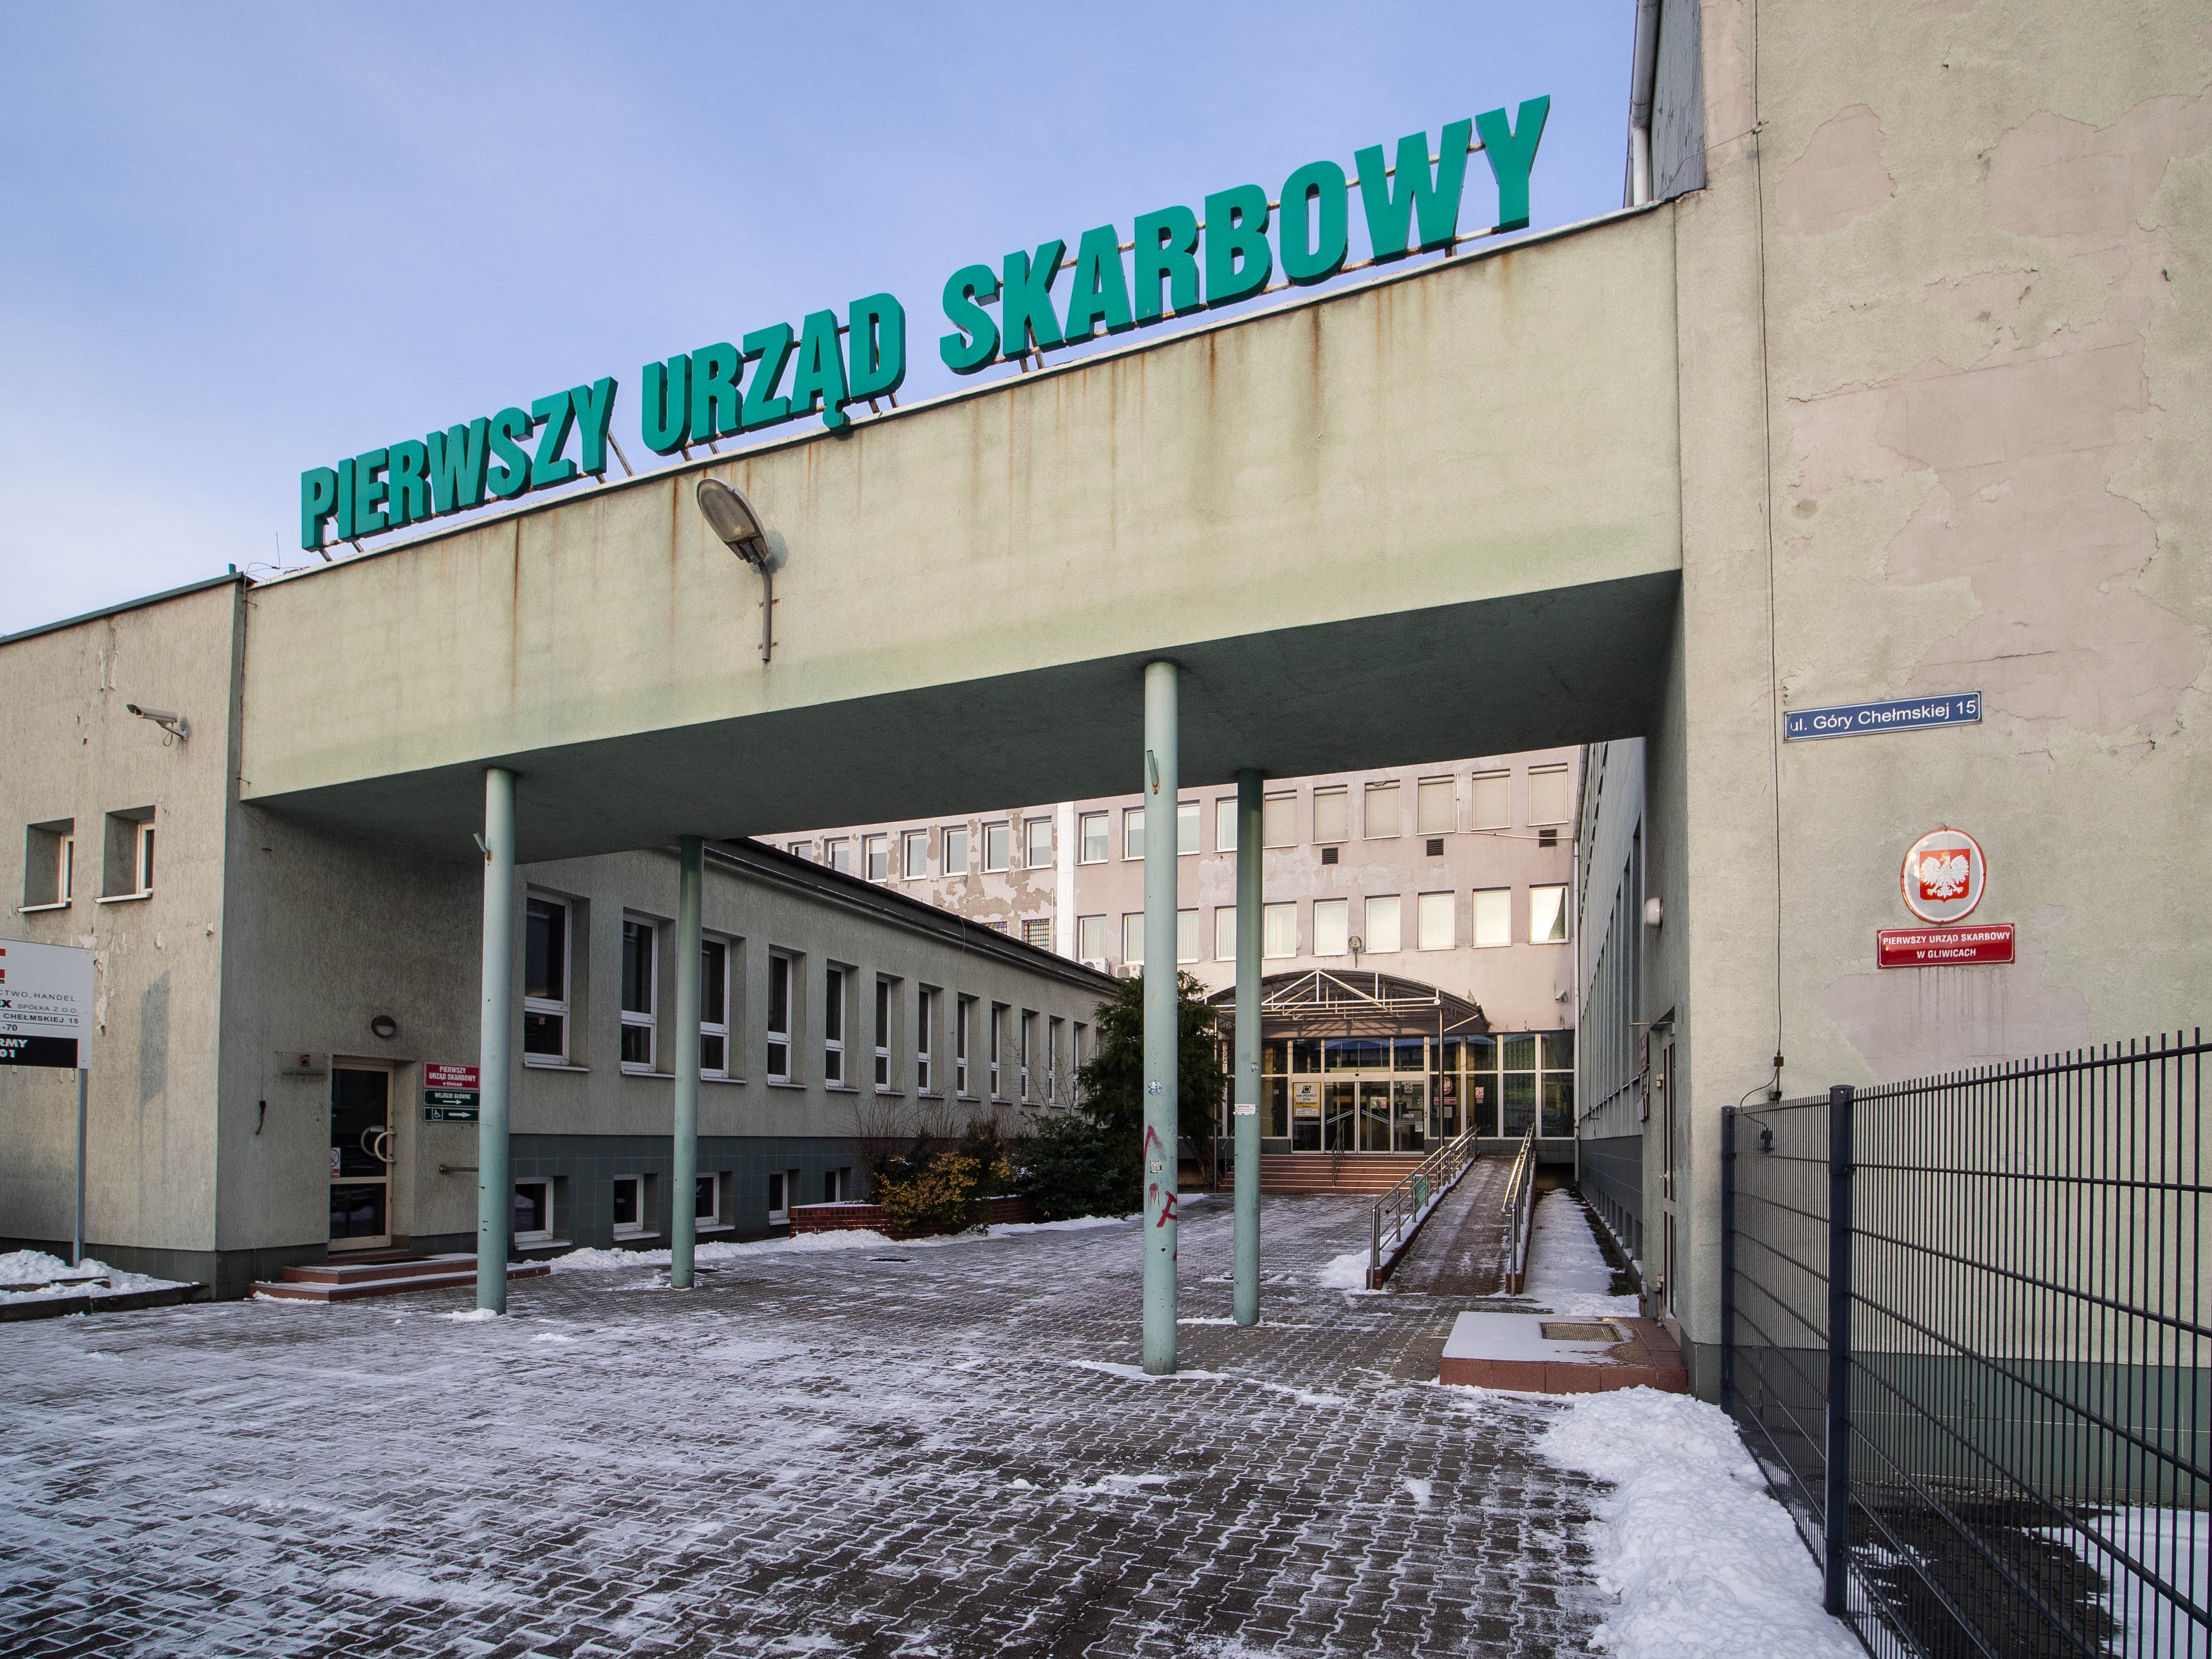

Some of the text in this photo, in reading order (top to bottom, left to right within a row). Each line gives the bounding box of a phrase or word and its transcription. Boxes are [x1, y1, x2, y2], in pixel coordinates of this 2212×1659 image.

[301, 94, 1551, 552] PIERWSZY URZĄD SKARBOWY
[1790, 700, 1976, 731] ul. Góry Chełmskiej 15
[1883, 931, 2011, 945] PIERWSZY URZĄD SKARBOWY
[1927, 949, 1976, 958] GLIWICACH
[0, 999, 12, 1008] X
[18, 1003, 50, 1012] SPÓŁKA
[4, 1013, 64, 1023] CHEŁMSKIEJ
[429, 1072, 476, 1082] URZĄD SKARBOWY
